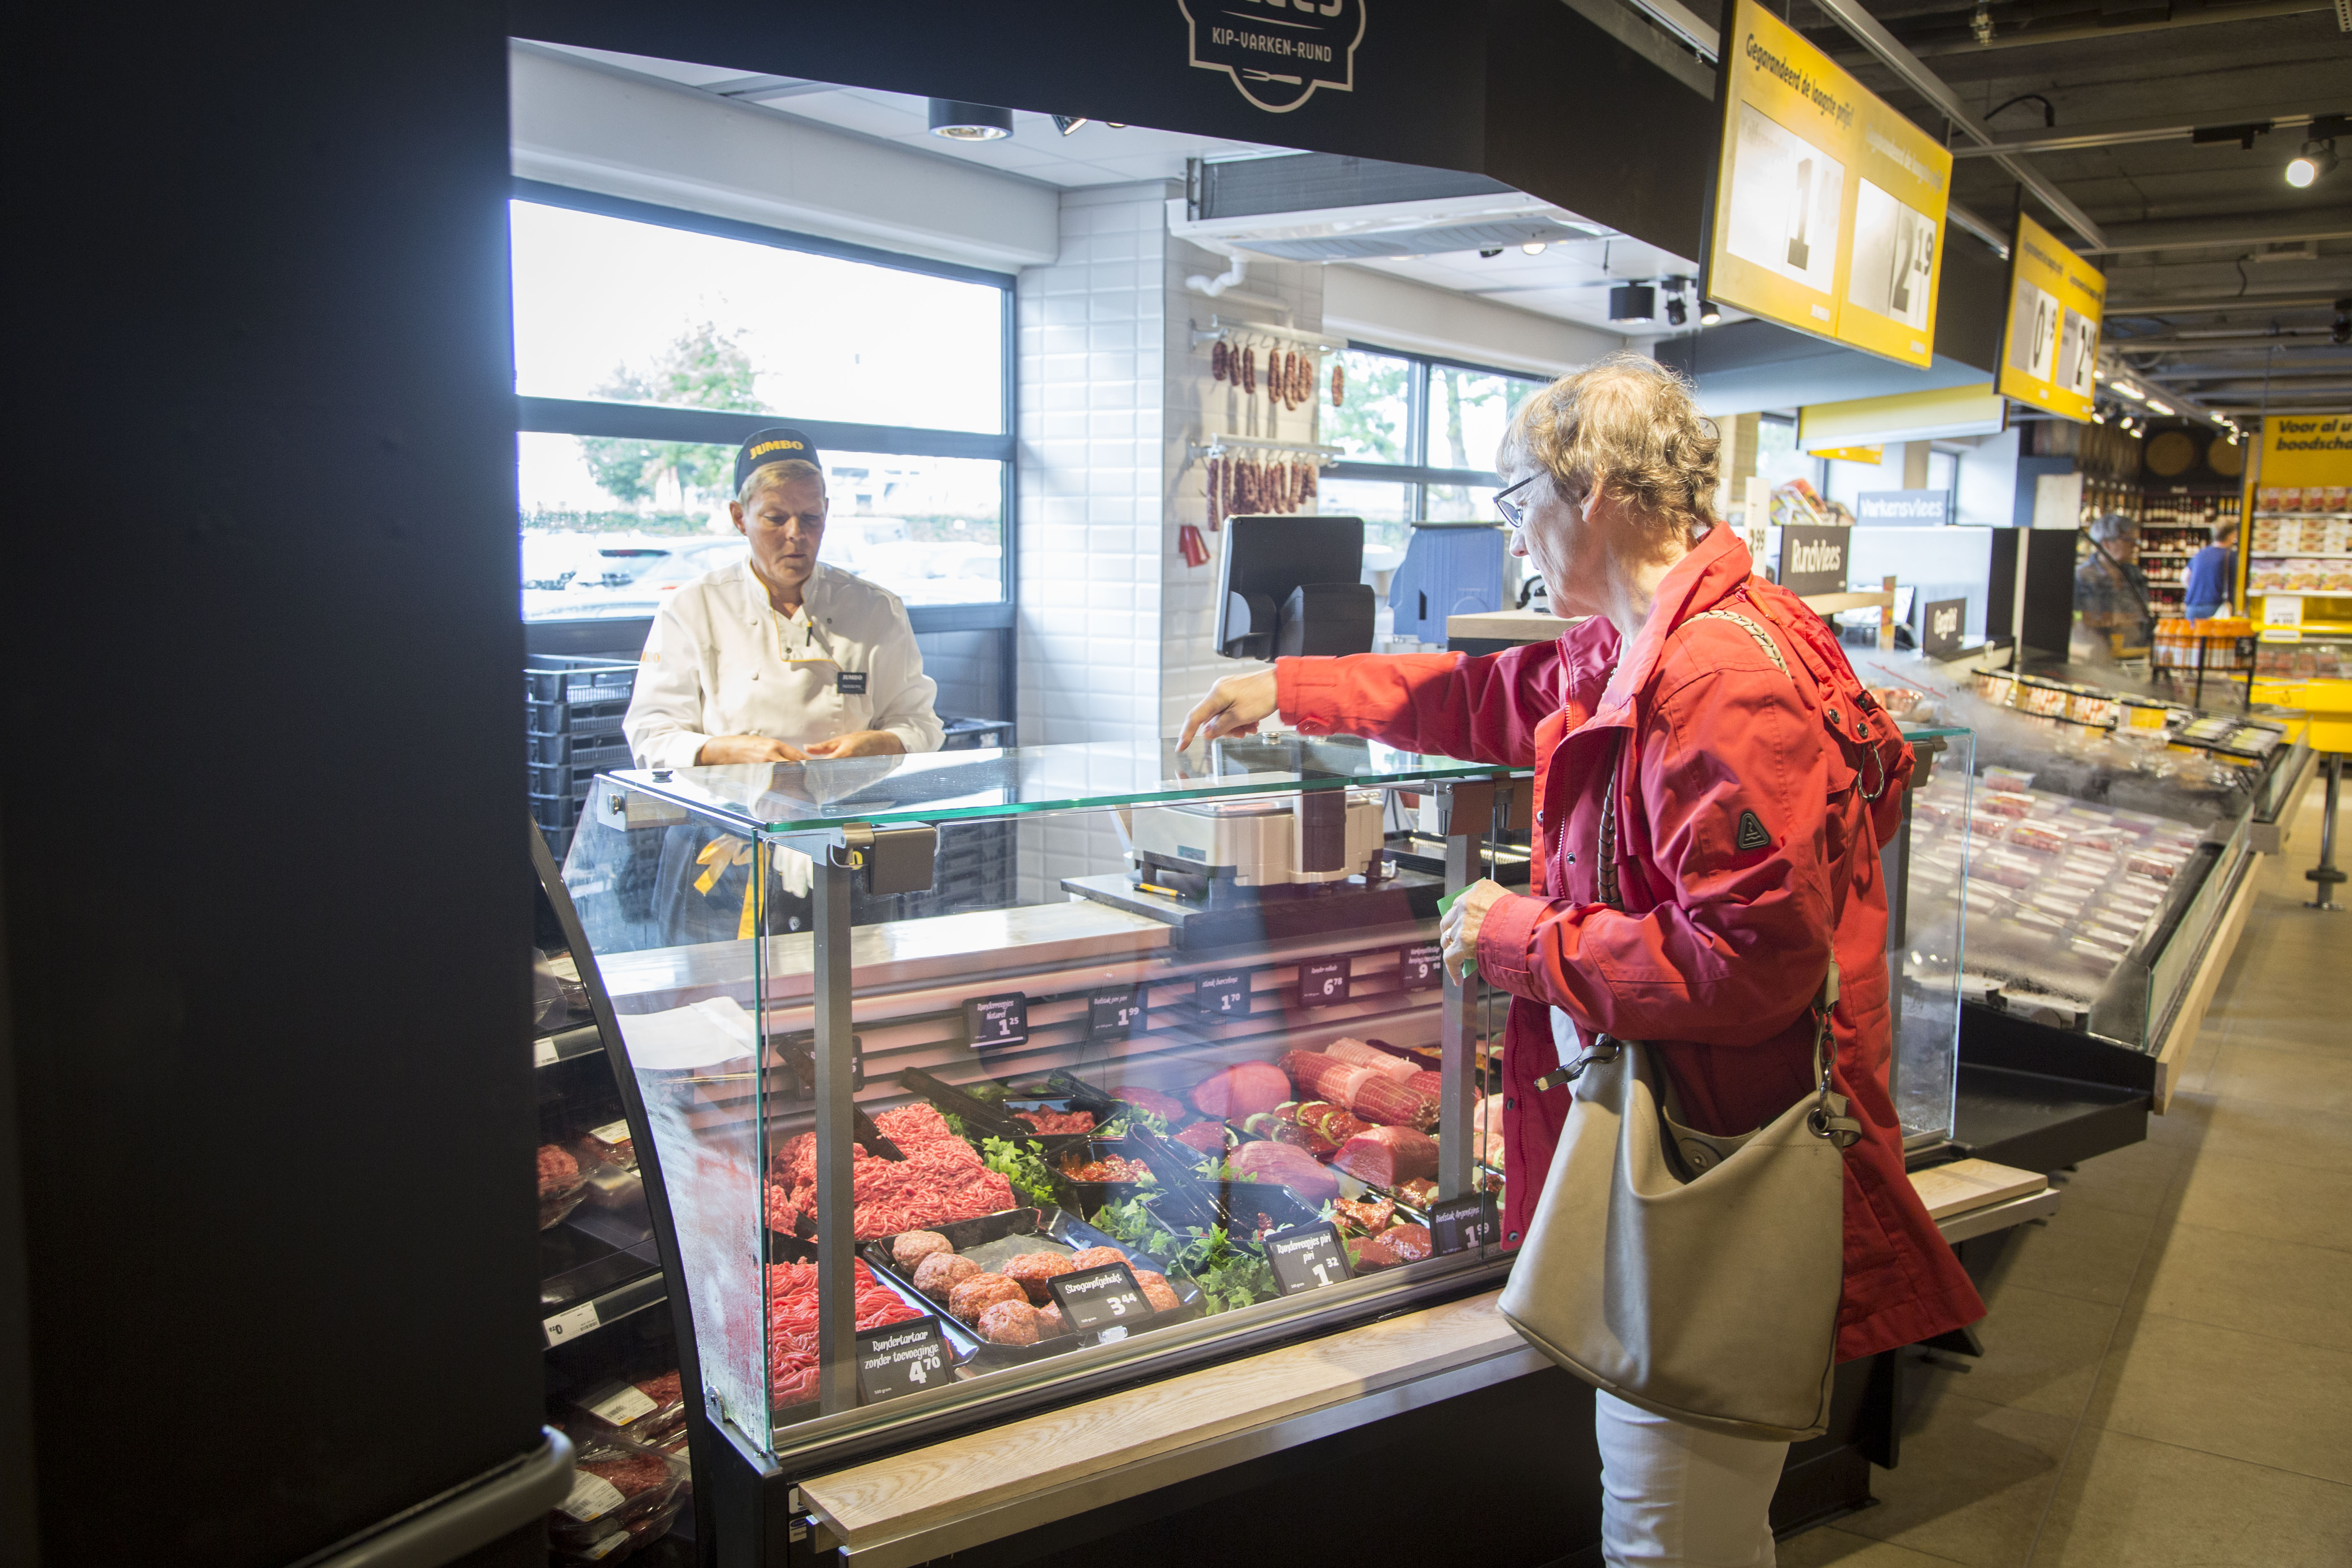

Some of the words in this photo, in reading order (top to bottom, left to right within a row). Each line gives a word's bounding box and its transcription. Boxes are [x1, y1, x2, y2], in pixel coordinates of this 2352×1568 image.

[1212, 27, 1332, 62] KIP-VARKEN-RUND
[1746, 33, 1802, 91] Gegarandeerd
[1801, 72, 1811, 98] de
[1811, 78, 1836, 116] laagste
[1893, 216, 1914, 313] 2
[1914, 228, 1934, 276] 19
[2280, 420, 2317, 433] Voor
[2321, 418, 2339, 433] al
[749, 440, 804, 460] JUMBO
[1790, 538, 1841, 574] Rundvlees
[1419, 963, 1428, 978] 9
[1324, 978, 1334, 995] 6
[1334, 977, 1343, 985] 78
[1221, 994, 1231, 1011] 1
[1230, 993, 1241, 1002] 70
[999, 1019, 1011, 1036] 1
[1009, 1016, 1019, 1025] 25
[1118, 1009, 1129, 1026] 1
[1128, 1006, 1140, 1016] 99
[1276, 1237, 1320, 1254] Runderreepjes
[1319, 1233, 1331, 1247] piri
[1465, 1225, 1480, 1248] 1
[1303, 1250, 1315, 1264] piri
[1312, 1263, 1334, 1287] 1
[1326, 1257, 1339, 1268] 32
[1065, 1273, 1123, 1294] Stroganofgehakt
[1106, 1297, 1126, 1316] 3
[1121, 1293, 1138, 1303] 44
[872, 1331, 928, 1352] Rundertartaar
[864, 1353, 892, 1370] zonder
[892, 1343, 940, 1363] toevoeginge
[909, 1360, 927, 1384] 4
[923, 1356, 941, 1370] 70
